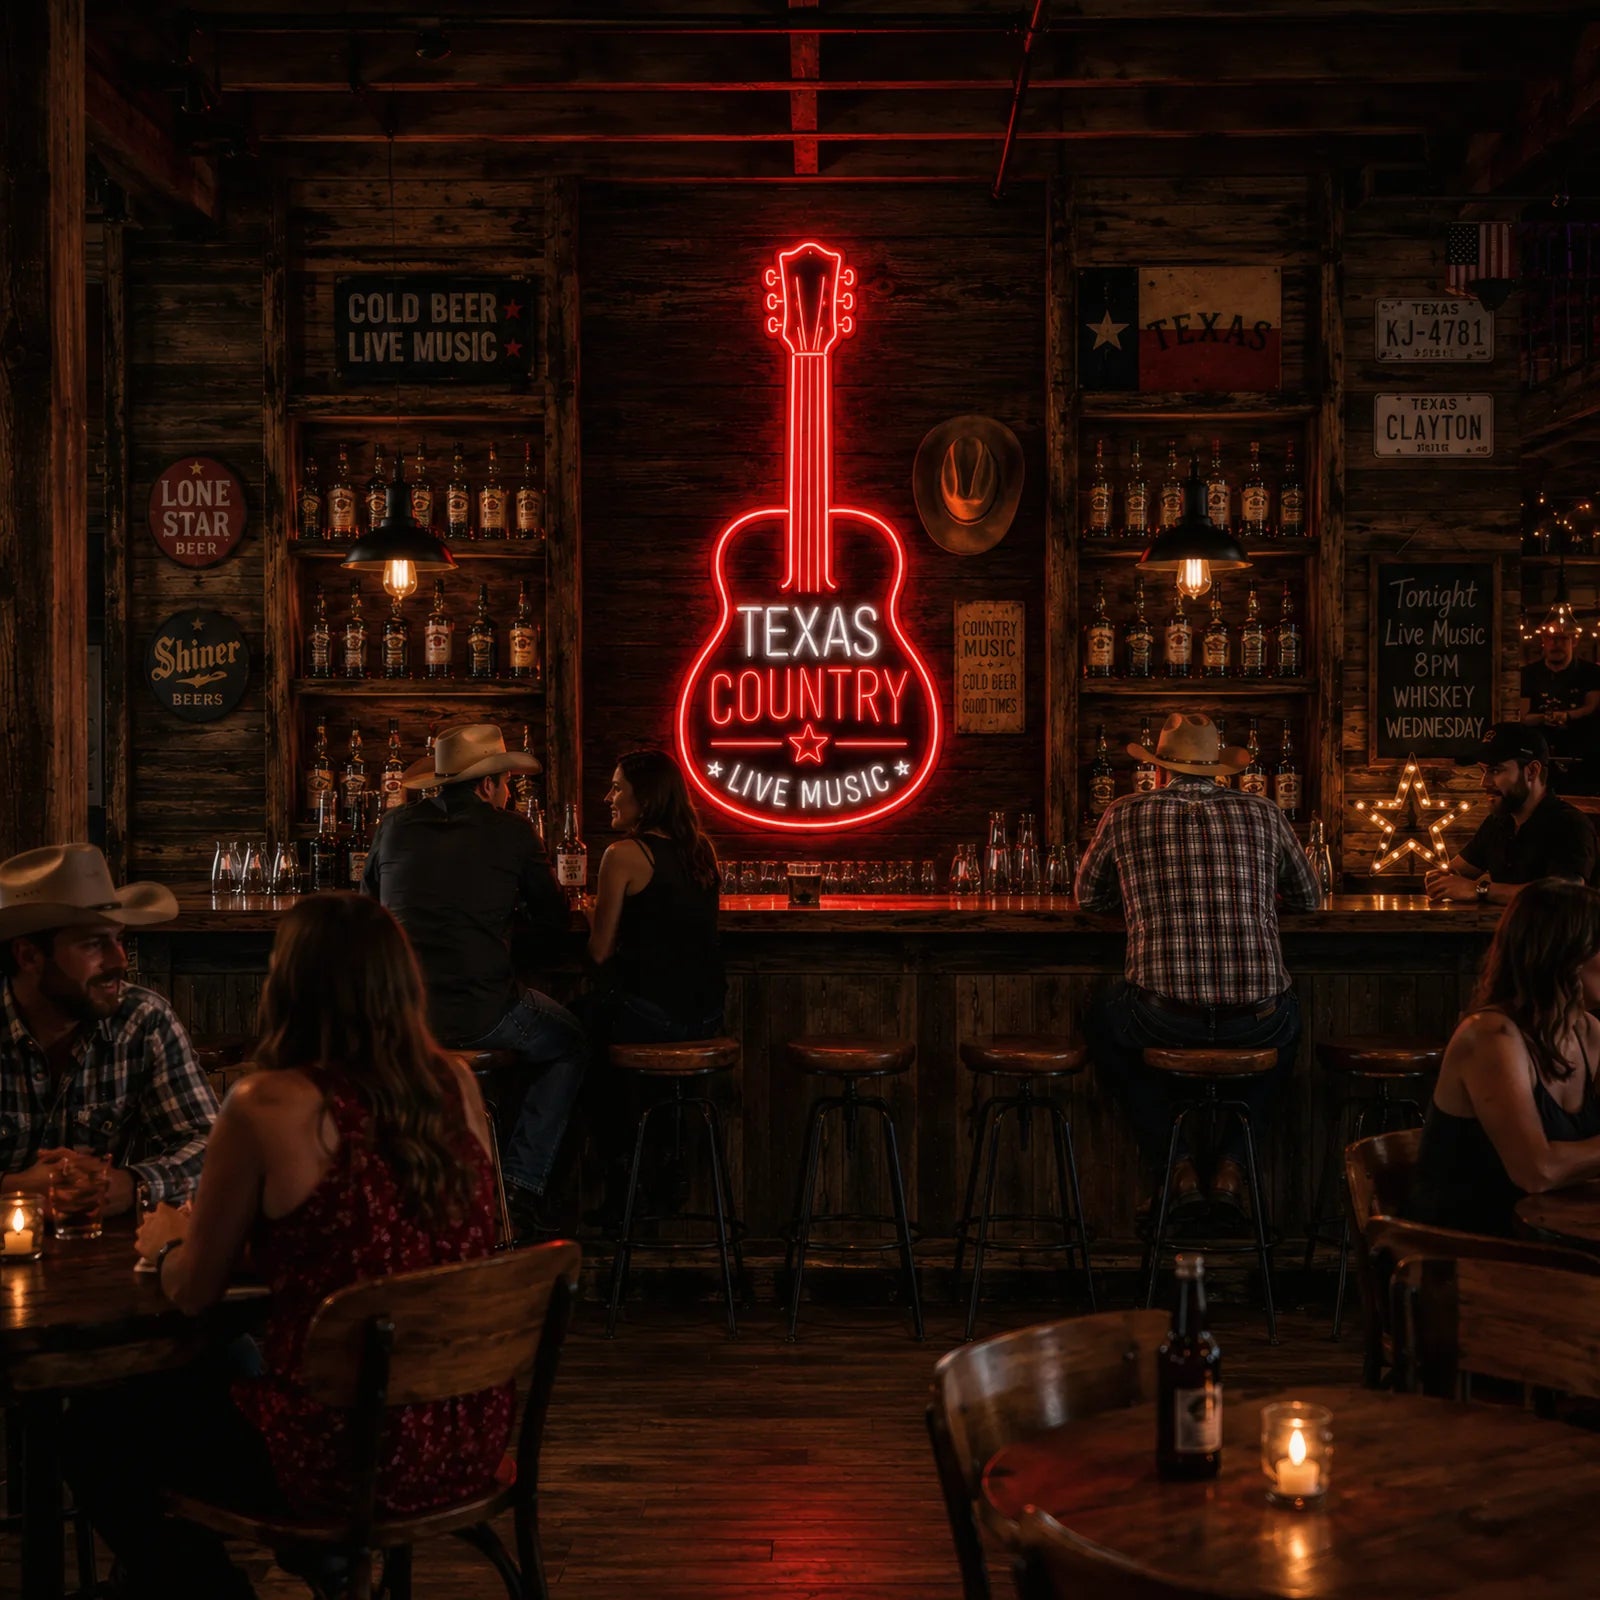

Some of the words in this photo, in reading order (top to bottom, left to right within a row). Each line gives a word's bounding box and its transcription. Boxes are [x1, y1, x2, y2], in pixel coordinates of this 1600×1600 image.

[348, 292, 420, 324] COLD
[431, 292, 498, 324] BEER
[1412, 303, 1459, 315] TEXAS
[1147, 312, 1273, 351] TEXAS
[1386, 319, 1484, 347] KJ-4781
[348, 331, 405, 363] LIVE
[413, 330, 498, 363] MUSIC
[1411, 398, 1458, 411] TEXAS
[1386, 413, 1481, 441] CLAYTON
[160, 479, 232, 507] LONE
[162, 510, 231, 538] STAR
[175, 541, 218, 555] BEER
[1389, 577, 1480, 618] Tonight
[735, 605, 880, 658] TEXAS
[962, 620, 1018, 637] COUNTRY
[1384, 618, 1425, 647] Live
[1431, 618, 1487, 648] Music
[150, 635, 241, 681] Shiner
[964, 639, 1016, 657] MUSIC
[1414, 651, 1461, 679] 8PM
[962, 673, 988, 690] COLD
[991, 673, 1017, 690] BEER
[172, 692, 225, 706] BEERS
[710, 666, 909, 726] COUNTRY
[962, 698, 988, 714] GOOD
[989, 698, 1017, 714] TIMES
[1392, 685, 1476, 709] WHISKEY
[1385, 715, 1485, 740] WEDNESDAY
[726, 763, 791, 807] LIVE
[800, 763, 891, 808] MUSIC
